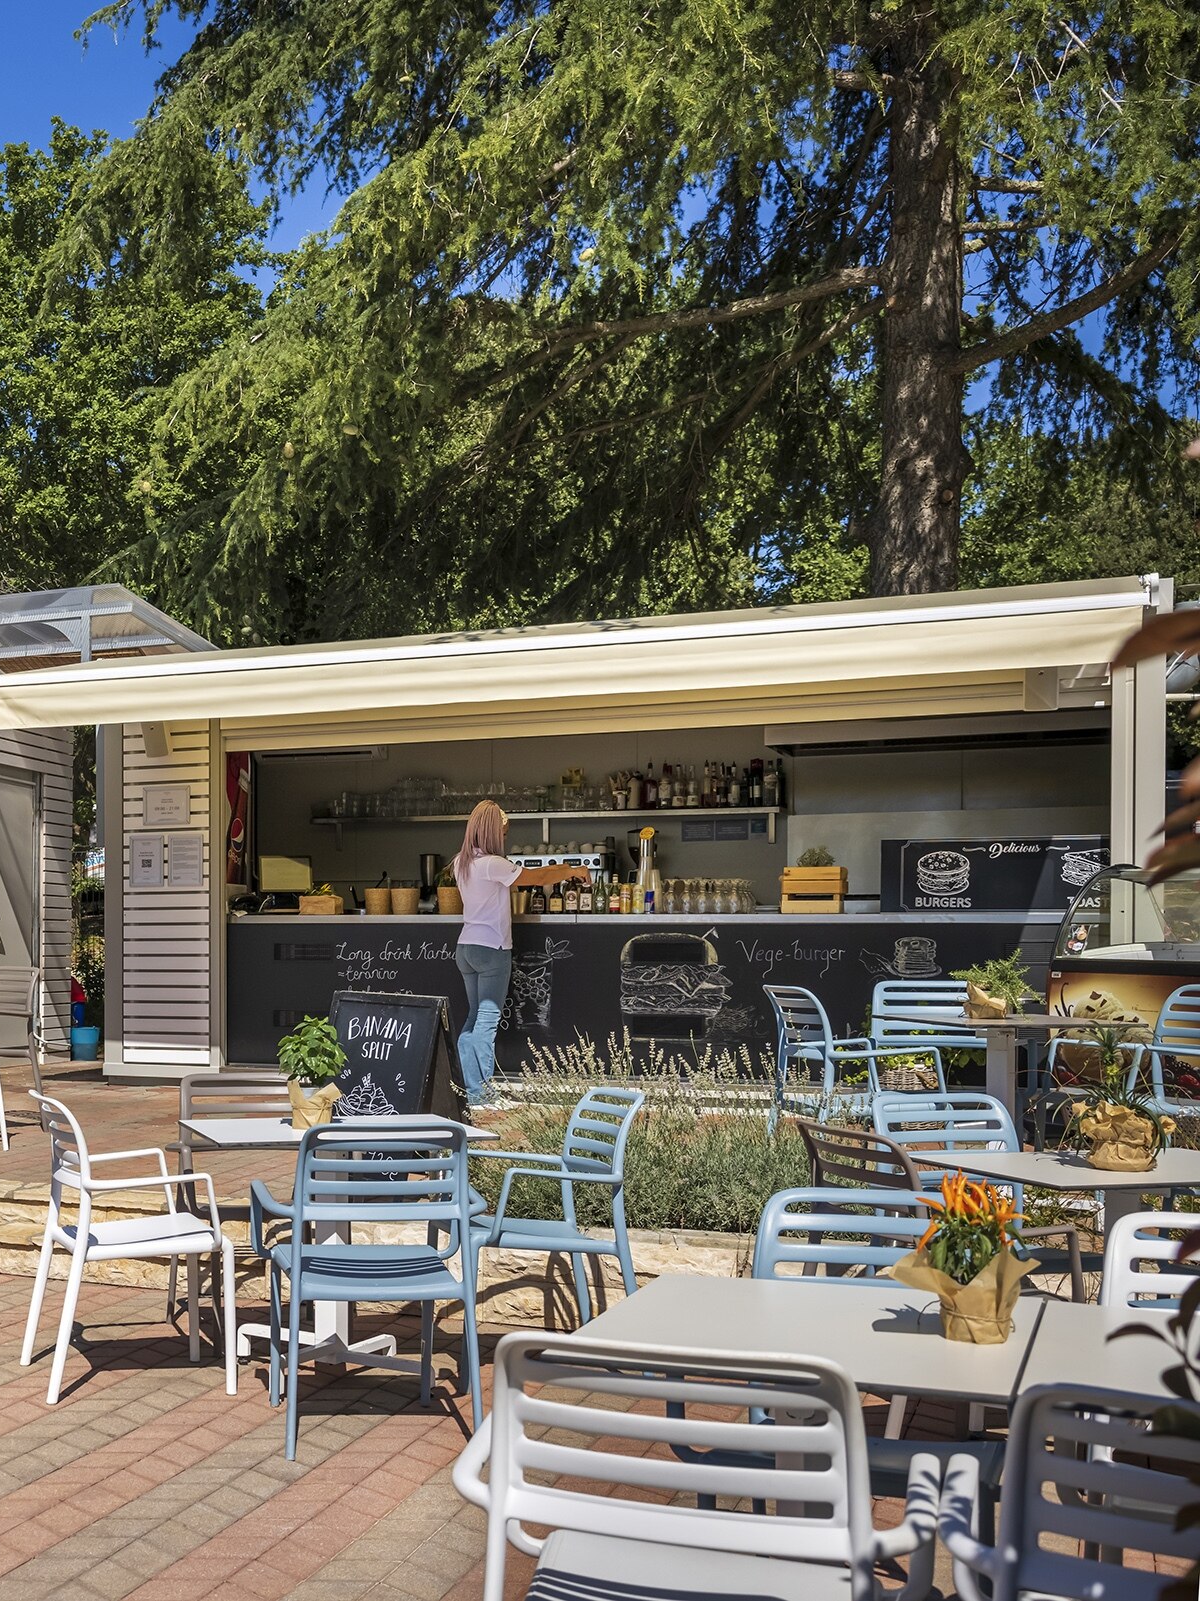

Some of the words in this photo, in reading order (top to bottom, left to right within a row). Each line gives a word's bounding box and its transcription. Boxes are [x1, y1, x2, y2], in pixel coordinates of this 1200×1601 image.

[988, 842, 1041, 859] Delicious
[914, 896, 972, 908] BURGERS
[336, 941, 375, 970] Long
[379, 940, 413, 961] drink
[416, 941, 457, 960] Karbu
[735, 939, 846, 979] Vege-burger
[347, 1015, 413, 1049] BANANA
[360, 1041, 394, 1061] SPLIT
